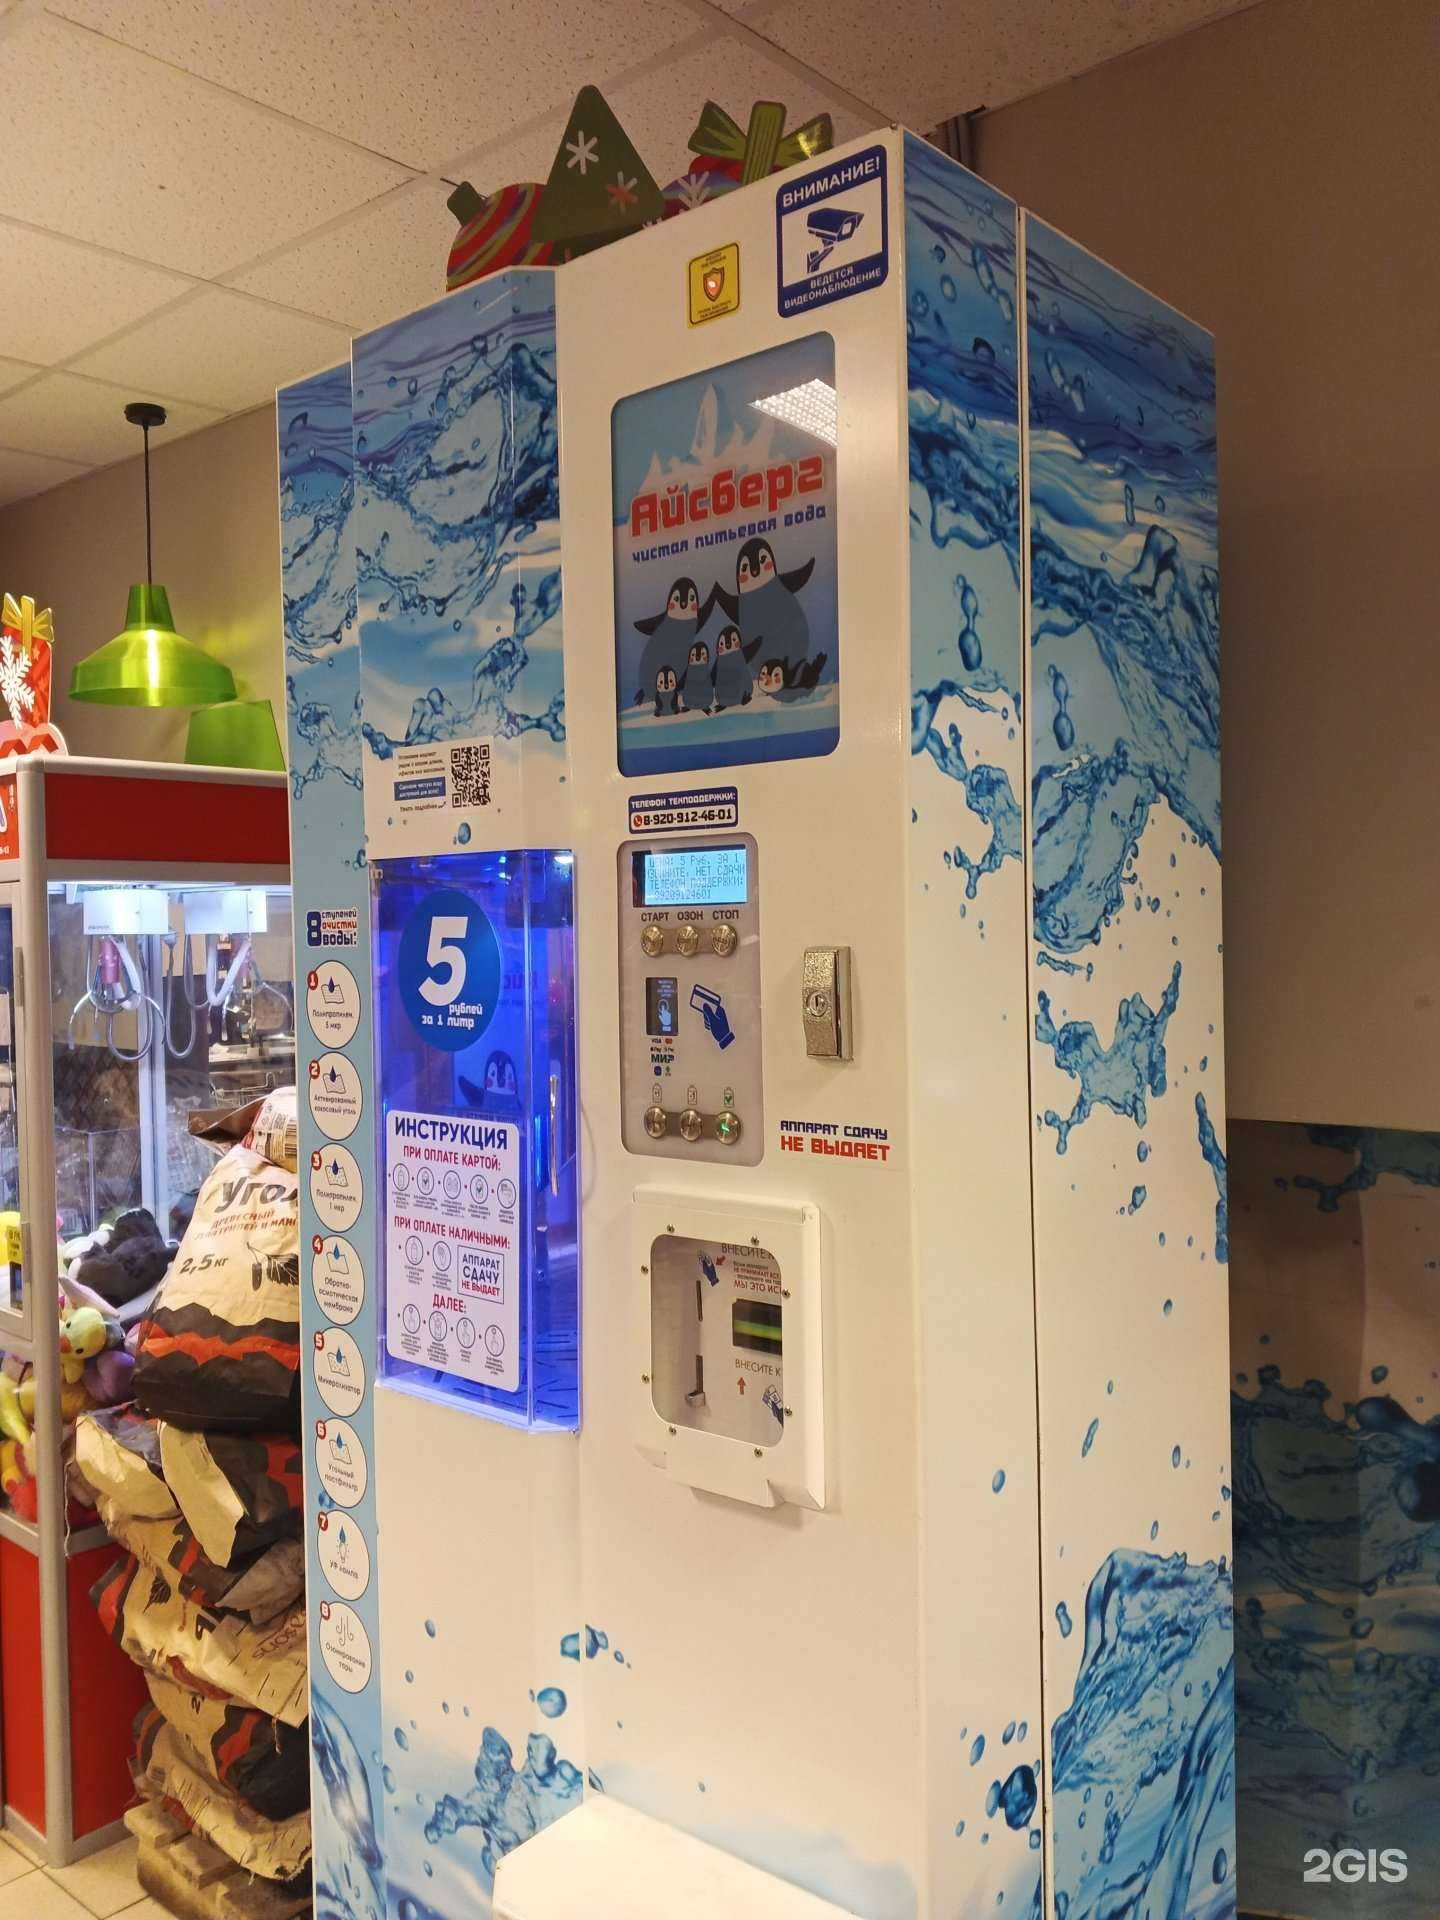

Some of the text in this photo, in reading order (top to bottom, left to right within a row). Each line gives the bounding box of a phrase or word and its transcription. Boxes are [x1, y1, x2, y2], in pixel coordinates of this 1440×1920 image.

[782, 156, 880, 208] ВНИМАНИЕ!
[810, 266, 854, 289] ВЕДЕТСЯ
[784, 267, 881, 309] ВИДЕОНАБЛЮДЕНИЕ
[631, 456, 823, 537] Айсберг
[632, 503, 826, 563] чистая питьевая вода
[631, 792, 736, 809] ТЕЛЕФОН ТЕХПОДДЕРЖКИ:
[643, 808, 733, 826] 8-920-912-46-01
[695, 865, 712, 877] НЕТ
[640, 909, 740, 921] СТАРТ ОЗОН СТОП
[307, 908, 357, 946] 8 ступеней
[322, 920, 357, 930] очистки
[322, 930, 357, 945] воды:
[418, 916, 468, 1006] 5
[449, 1002, 484, 1016] рублей
[421, 1014, 475, 1030] за 1 литр
[651, 1054, 674, 1064] МИР
[395, 1116, 508, 1150] ИНСТРУКЦИЯ
[781, 1120, 888, 1141] АППАРАТ СДАЧУ
[781, 1135, 891, 1162] НЕ ВЫДАЕТ
[403, 1145, 502, 1172] ПРИ ОПЛАТЕ КАРТОЙ:
[394, 1215, 511, 1250] ПРИ ОПЛАТЕ НАЛИЧНЫМИ:
[721, 1242, 767, 1259] ВНЕСИТЕ
[180, 1253, 215, 1275] 2,5
[462, 1254, 500, 1270] АППАРАТ
[462, 1266, 500, 1285] СДАЧУ
[461, 1280, 471, 1290] НЕ
[472, 1282, 500, 1296] ВЫДАЕТ
[734, 1280, 748, 1289] МЫ
[750, 1282, 766, 1292] ЭТО
[432, 1293, 467, 1314] ДАЛЕЕ:
[735, 1358, 773, 1376] ВНЕСИТЕ
